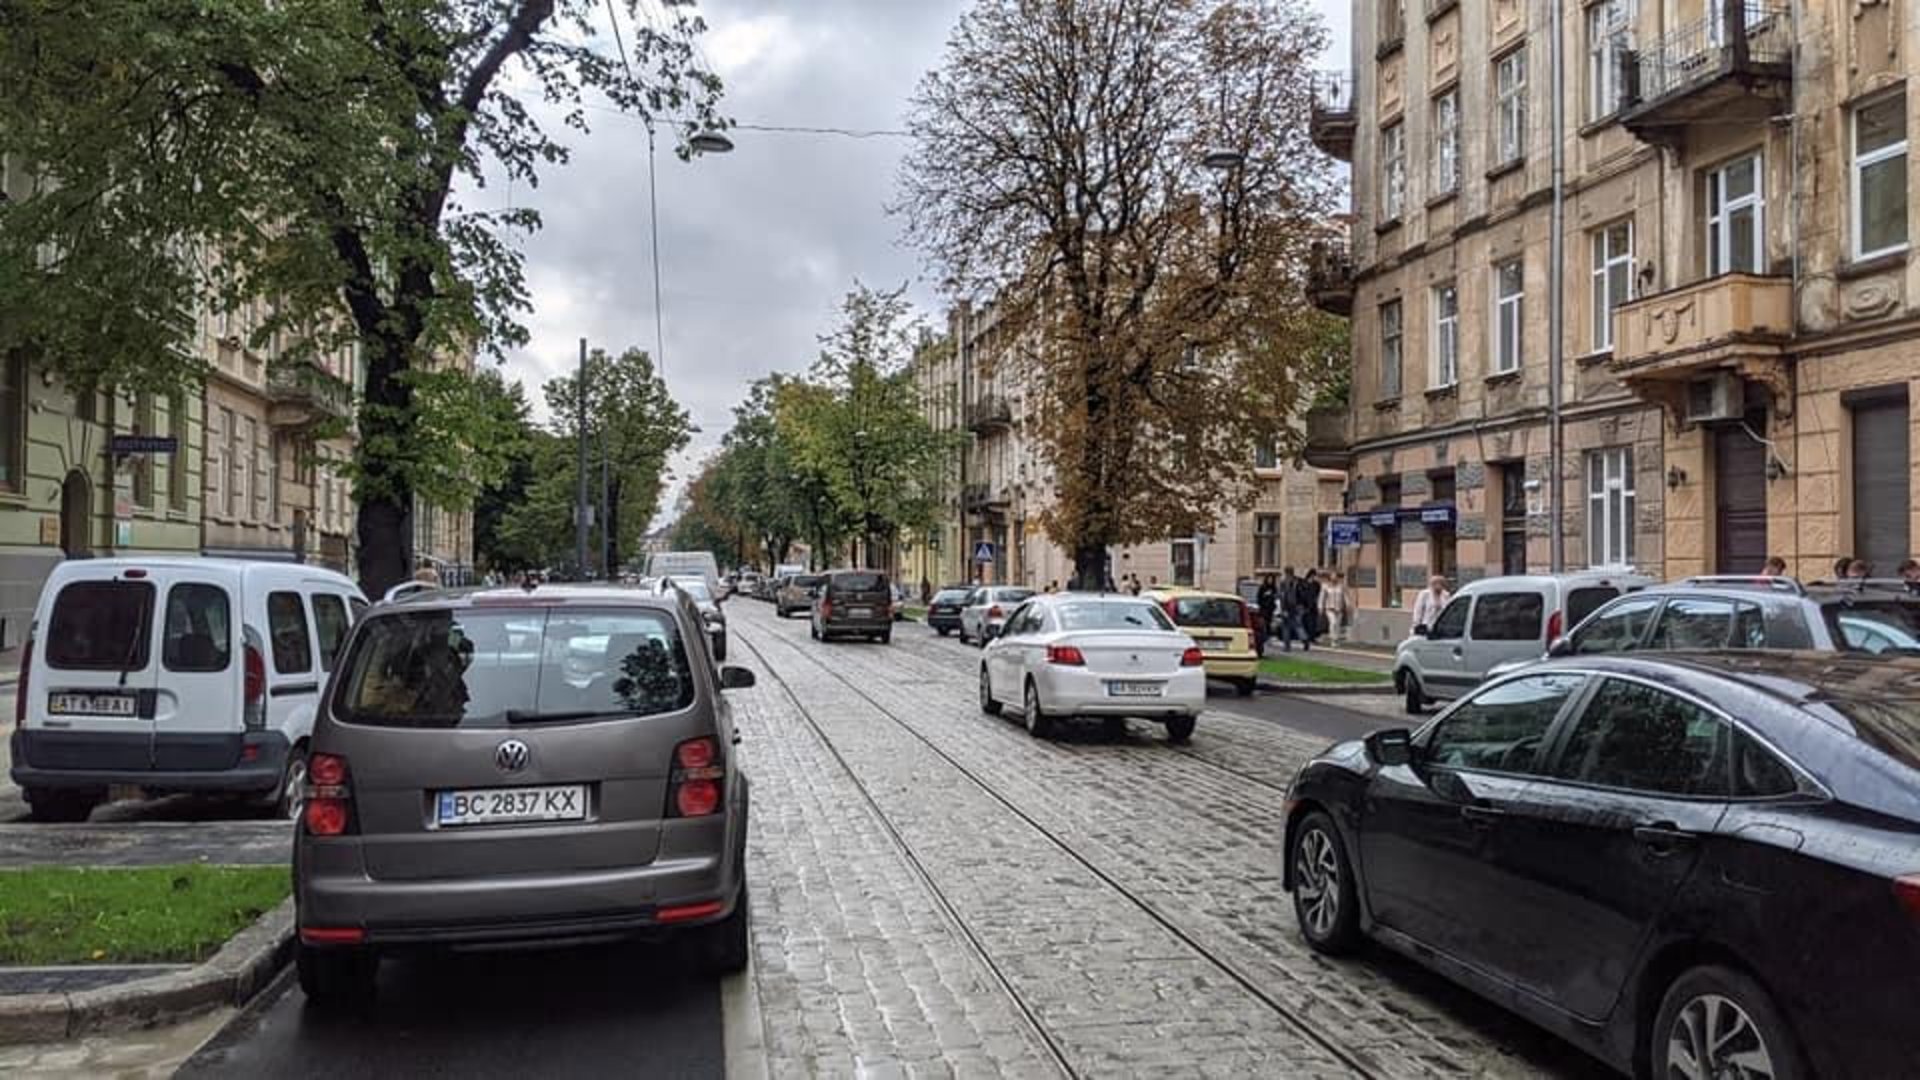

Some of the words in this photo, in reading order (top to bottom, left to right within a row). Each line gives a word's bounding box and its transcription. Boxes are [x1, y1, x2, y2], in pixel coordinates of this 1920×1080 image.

[454, 794, 485, 816] BC
[490, 791, 540, 815] 2837
[545, 789, 576, 812] KX
